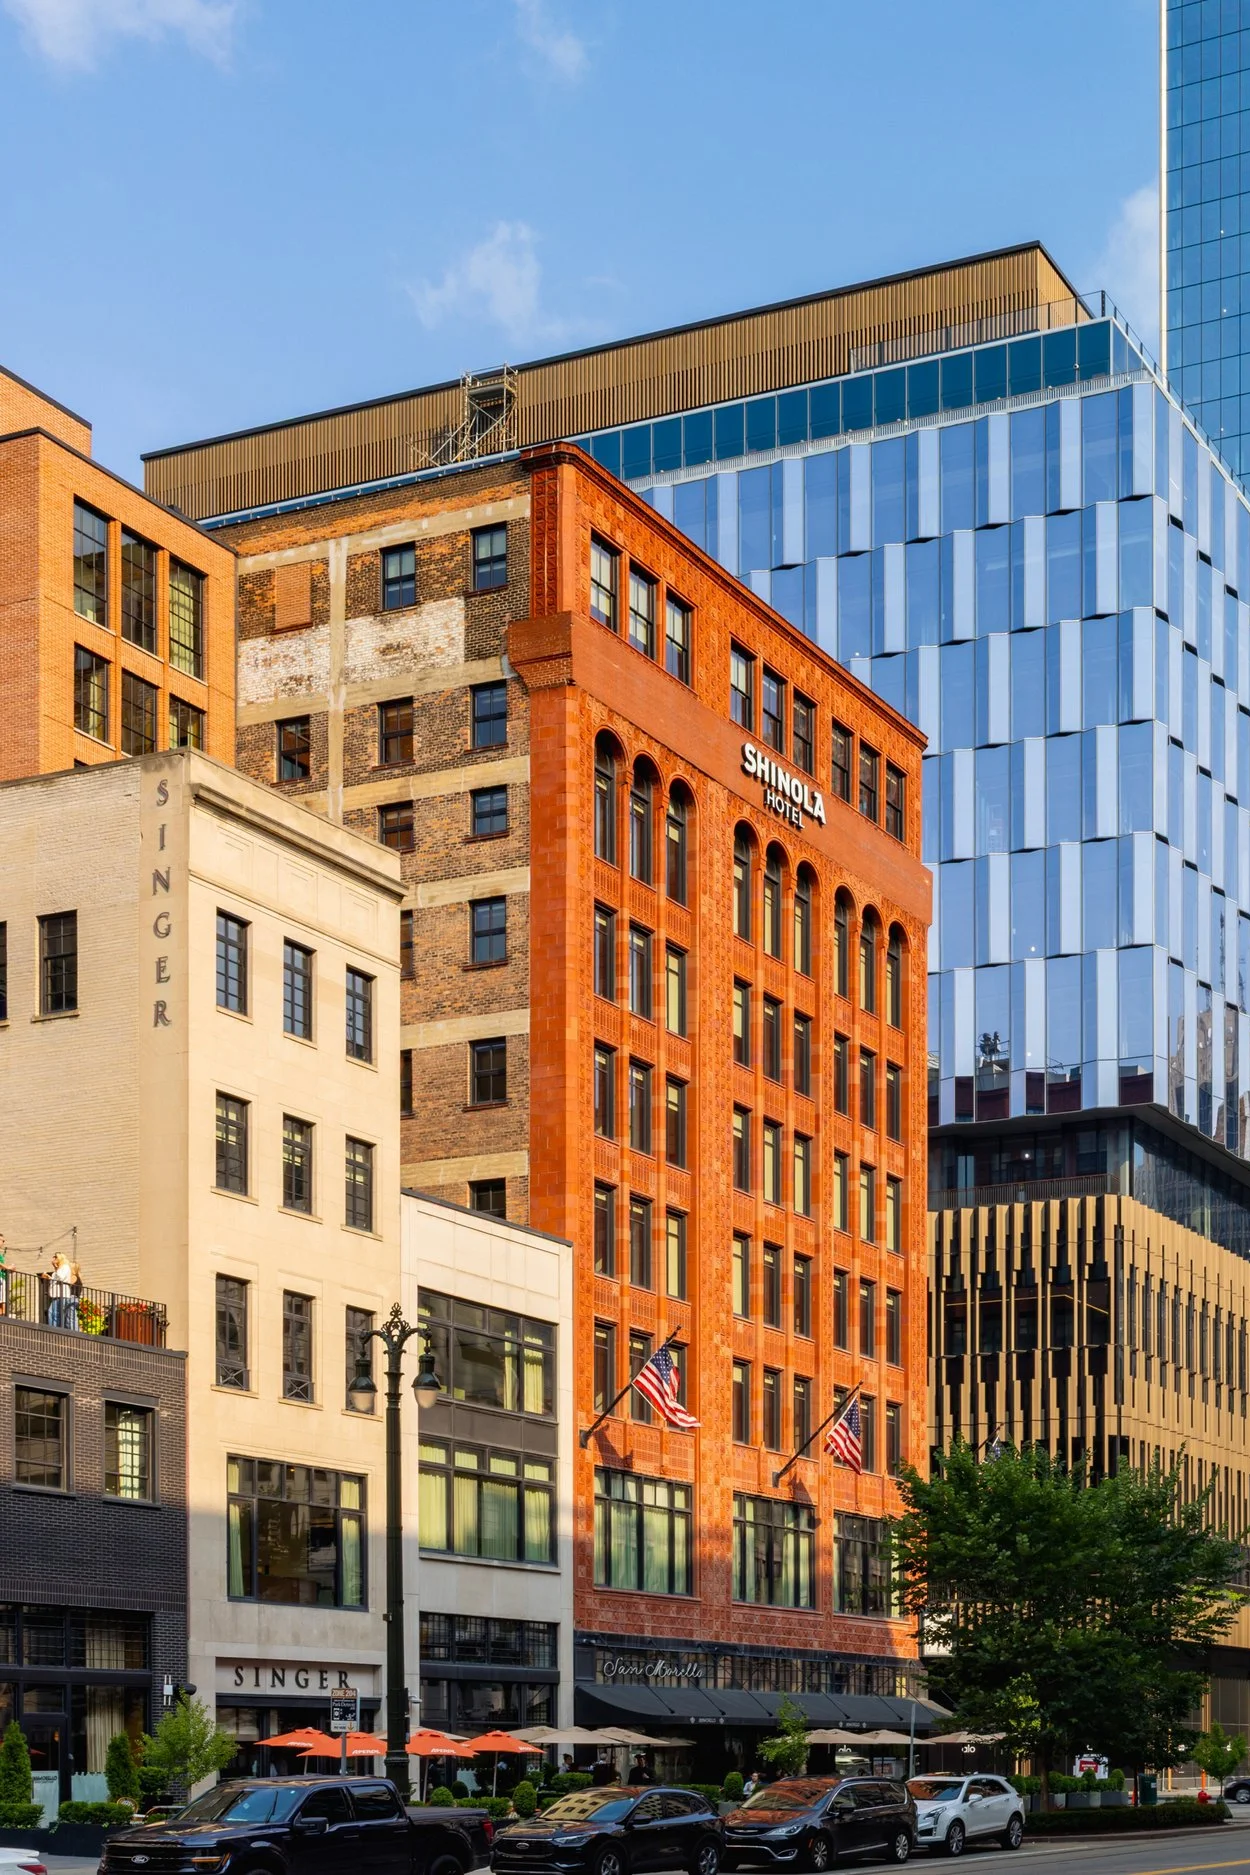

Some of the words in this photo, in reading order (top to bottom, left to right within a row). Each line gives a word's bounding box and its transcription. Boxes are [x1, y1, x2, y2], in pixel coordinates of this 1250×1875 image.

[743, 742, 827, 825] SHINOLA
[765, 788, 805, 829] HOTEL
[152, 779, 171, 1027] SINGER
[234, 1666, 350, 1689] SINGER
[603, 1657, 643, 1677] San
[645, 1660, 703, 1678] Morello
[961, 1744, 976, 1753] alo
